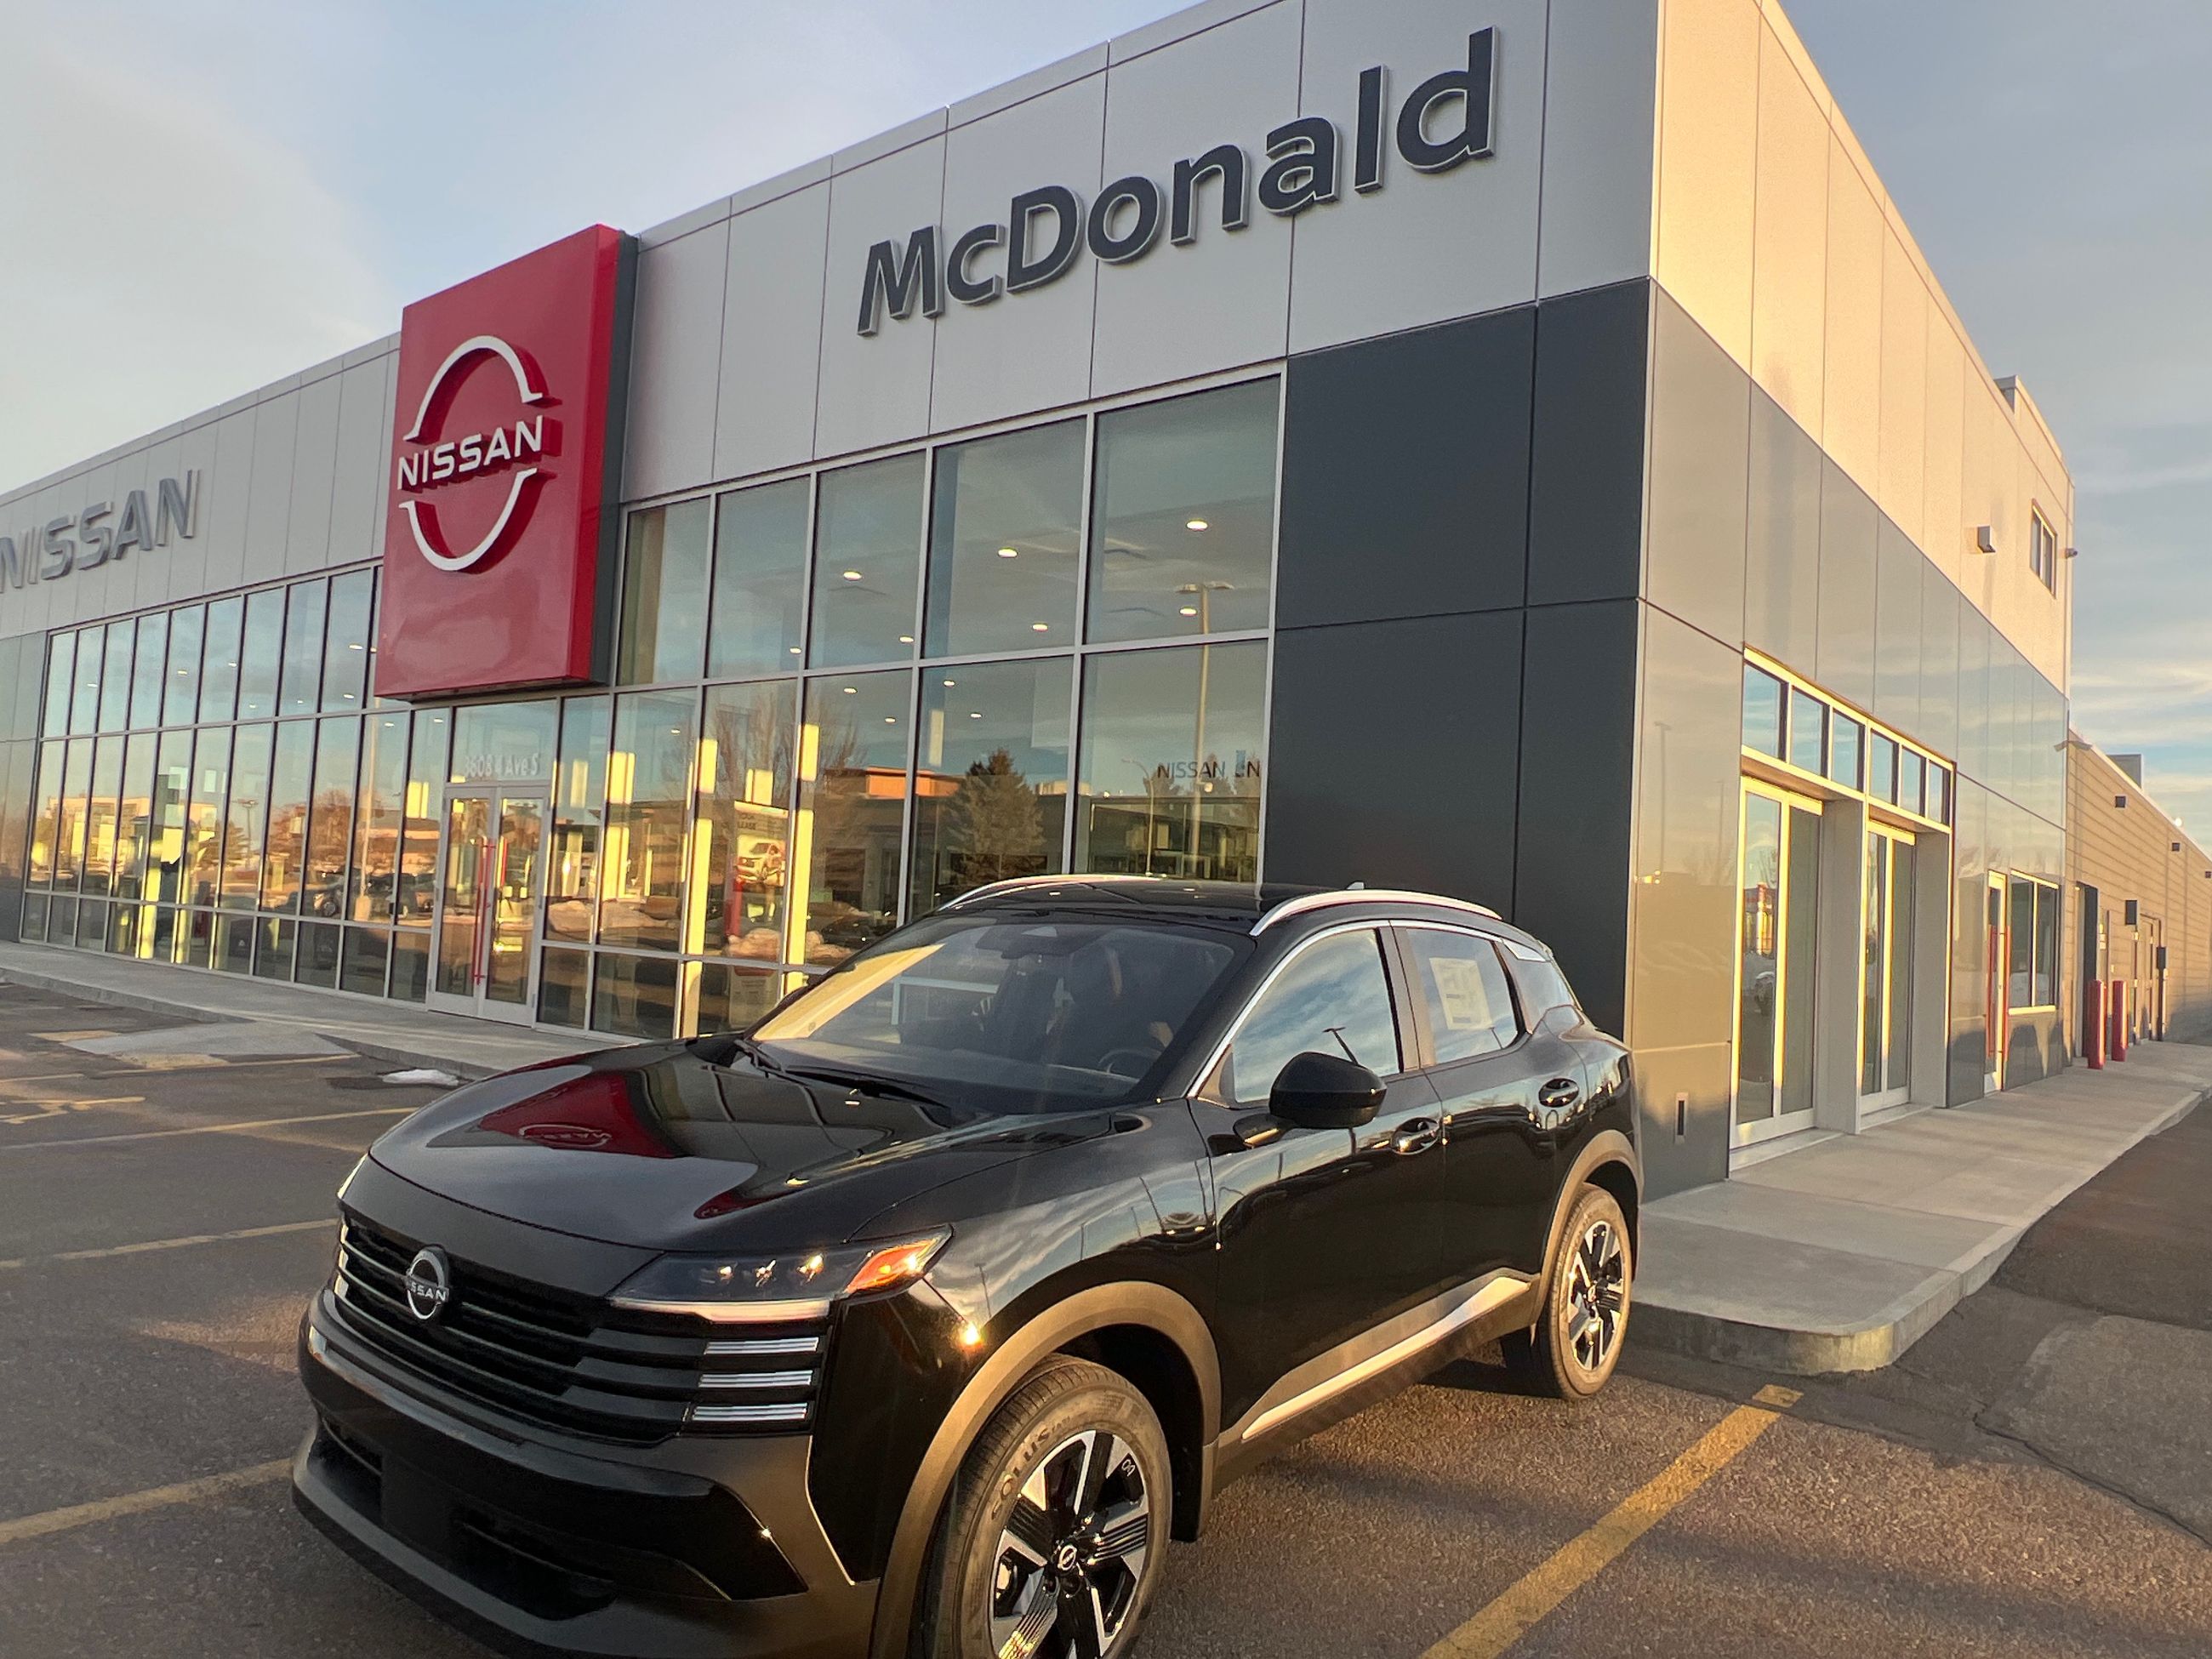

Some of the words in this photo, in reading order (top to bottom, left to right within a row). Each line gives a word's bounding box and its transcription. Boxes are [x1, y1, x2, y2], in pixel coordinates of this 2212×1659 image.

[857, 25, 1500, 337] McDonald
[397, 414, 544, 491] NISSAN
[505, 754, 528, 776] Ave
[530, 752, 539, 776] S
